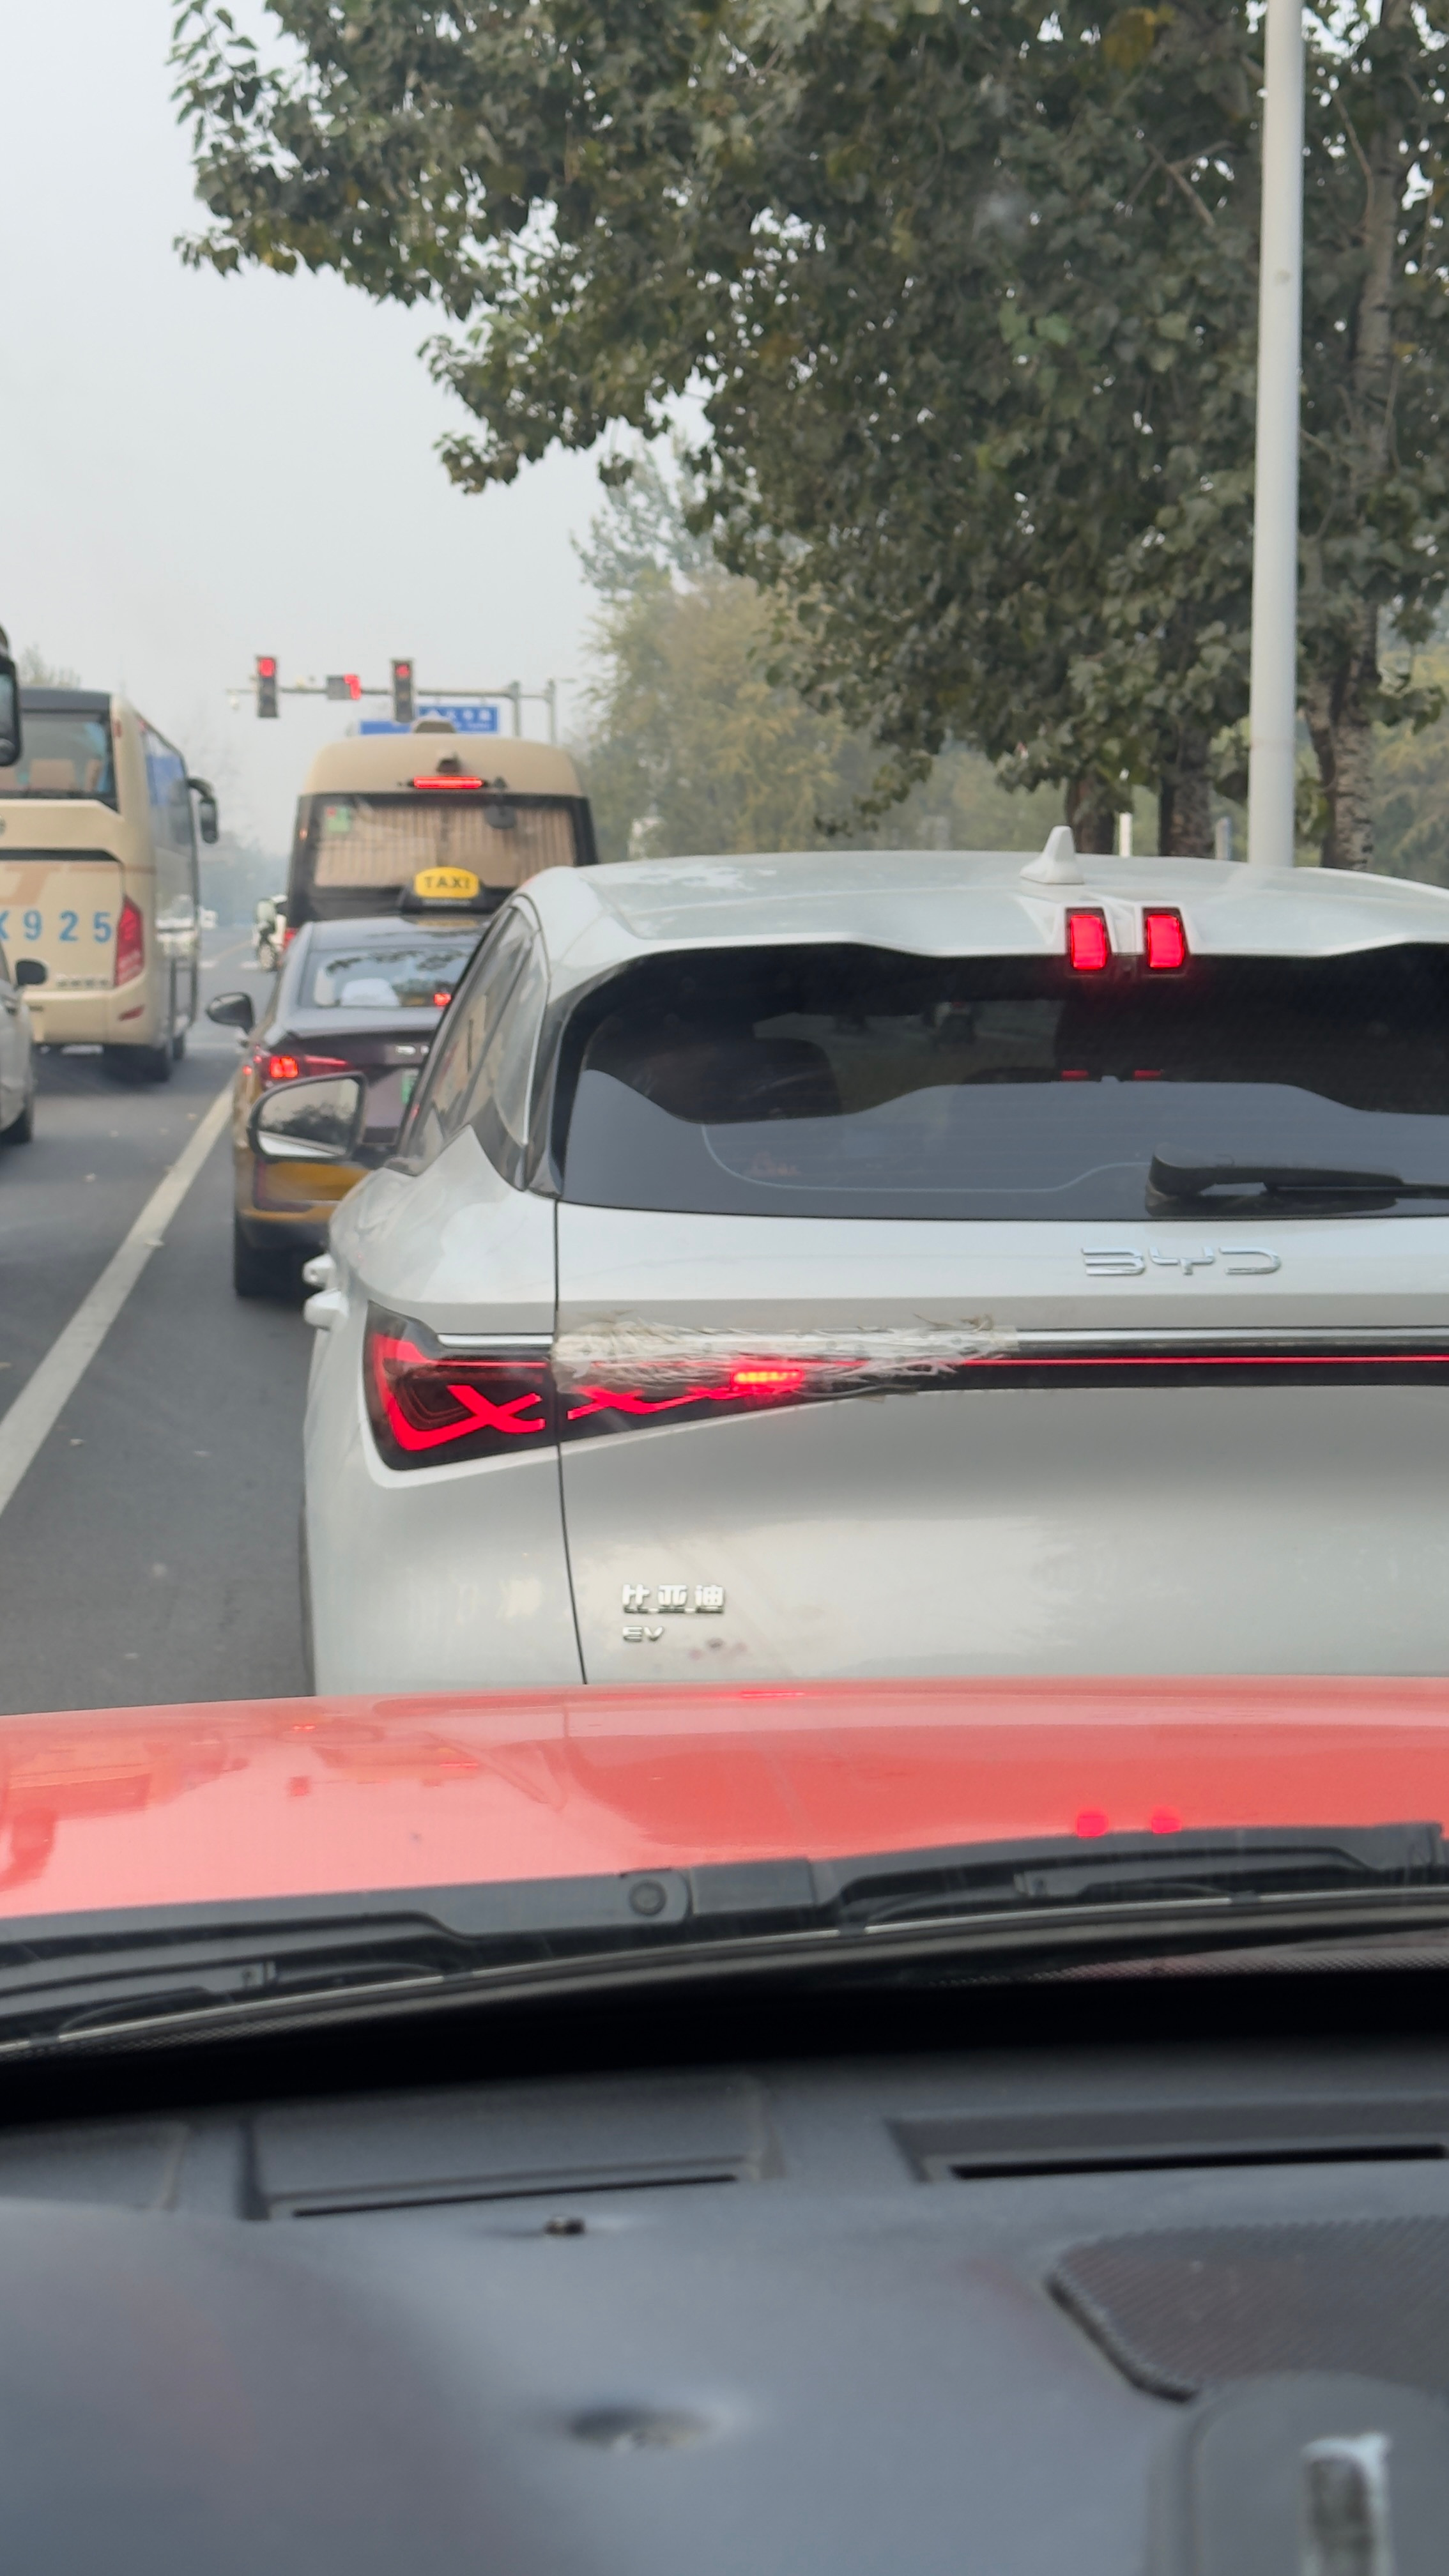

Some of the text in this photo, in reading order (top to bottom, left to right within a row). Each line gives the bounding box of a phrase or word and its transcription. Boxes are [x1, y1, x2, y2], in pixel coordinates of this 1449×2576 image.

[424, 876, 471, 889] TAXI
[1081, 1246, 1282, 1276] BYD
[622, 1584, 724, 1614] 比亚迪
[622, 1626, 664, 1643] EV
